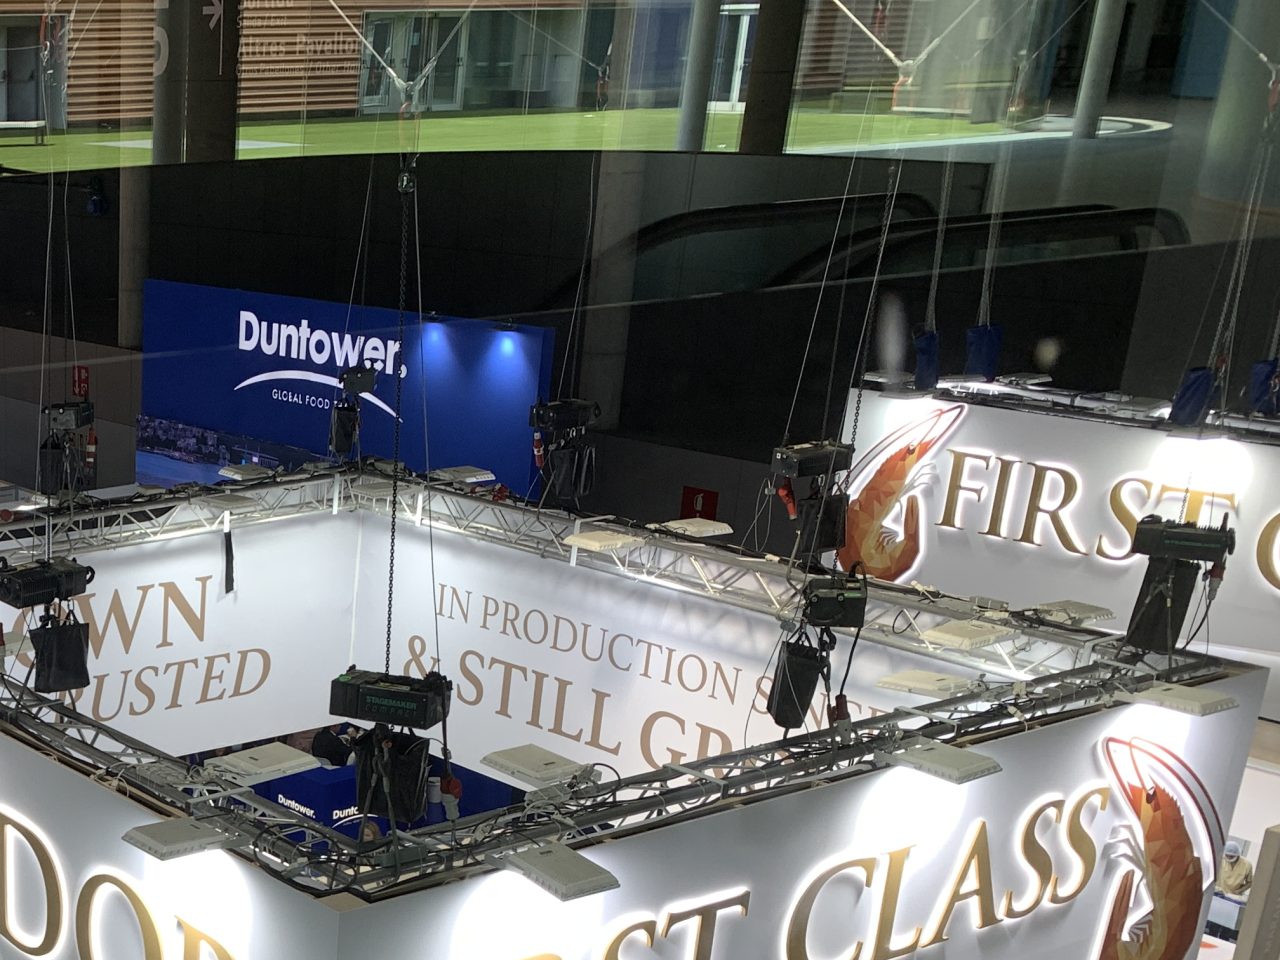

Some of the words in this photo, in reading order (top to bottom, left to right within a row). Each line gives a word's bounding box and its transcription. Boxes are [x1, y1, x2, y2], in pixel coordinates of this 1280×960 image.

[272, 388, 303, 404] GLOBAL
[305, 395, 330, 410] FOOD
[935, 448, 1236, 563] FIRST
[52, 647, 272, 725] RUSTED
[436, 582, 472, 625] IN
[480, 593, 743, 706] PRODUCTION
[457, 649, 622, 759] STILL
